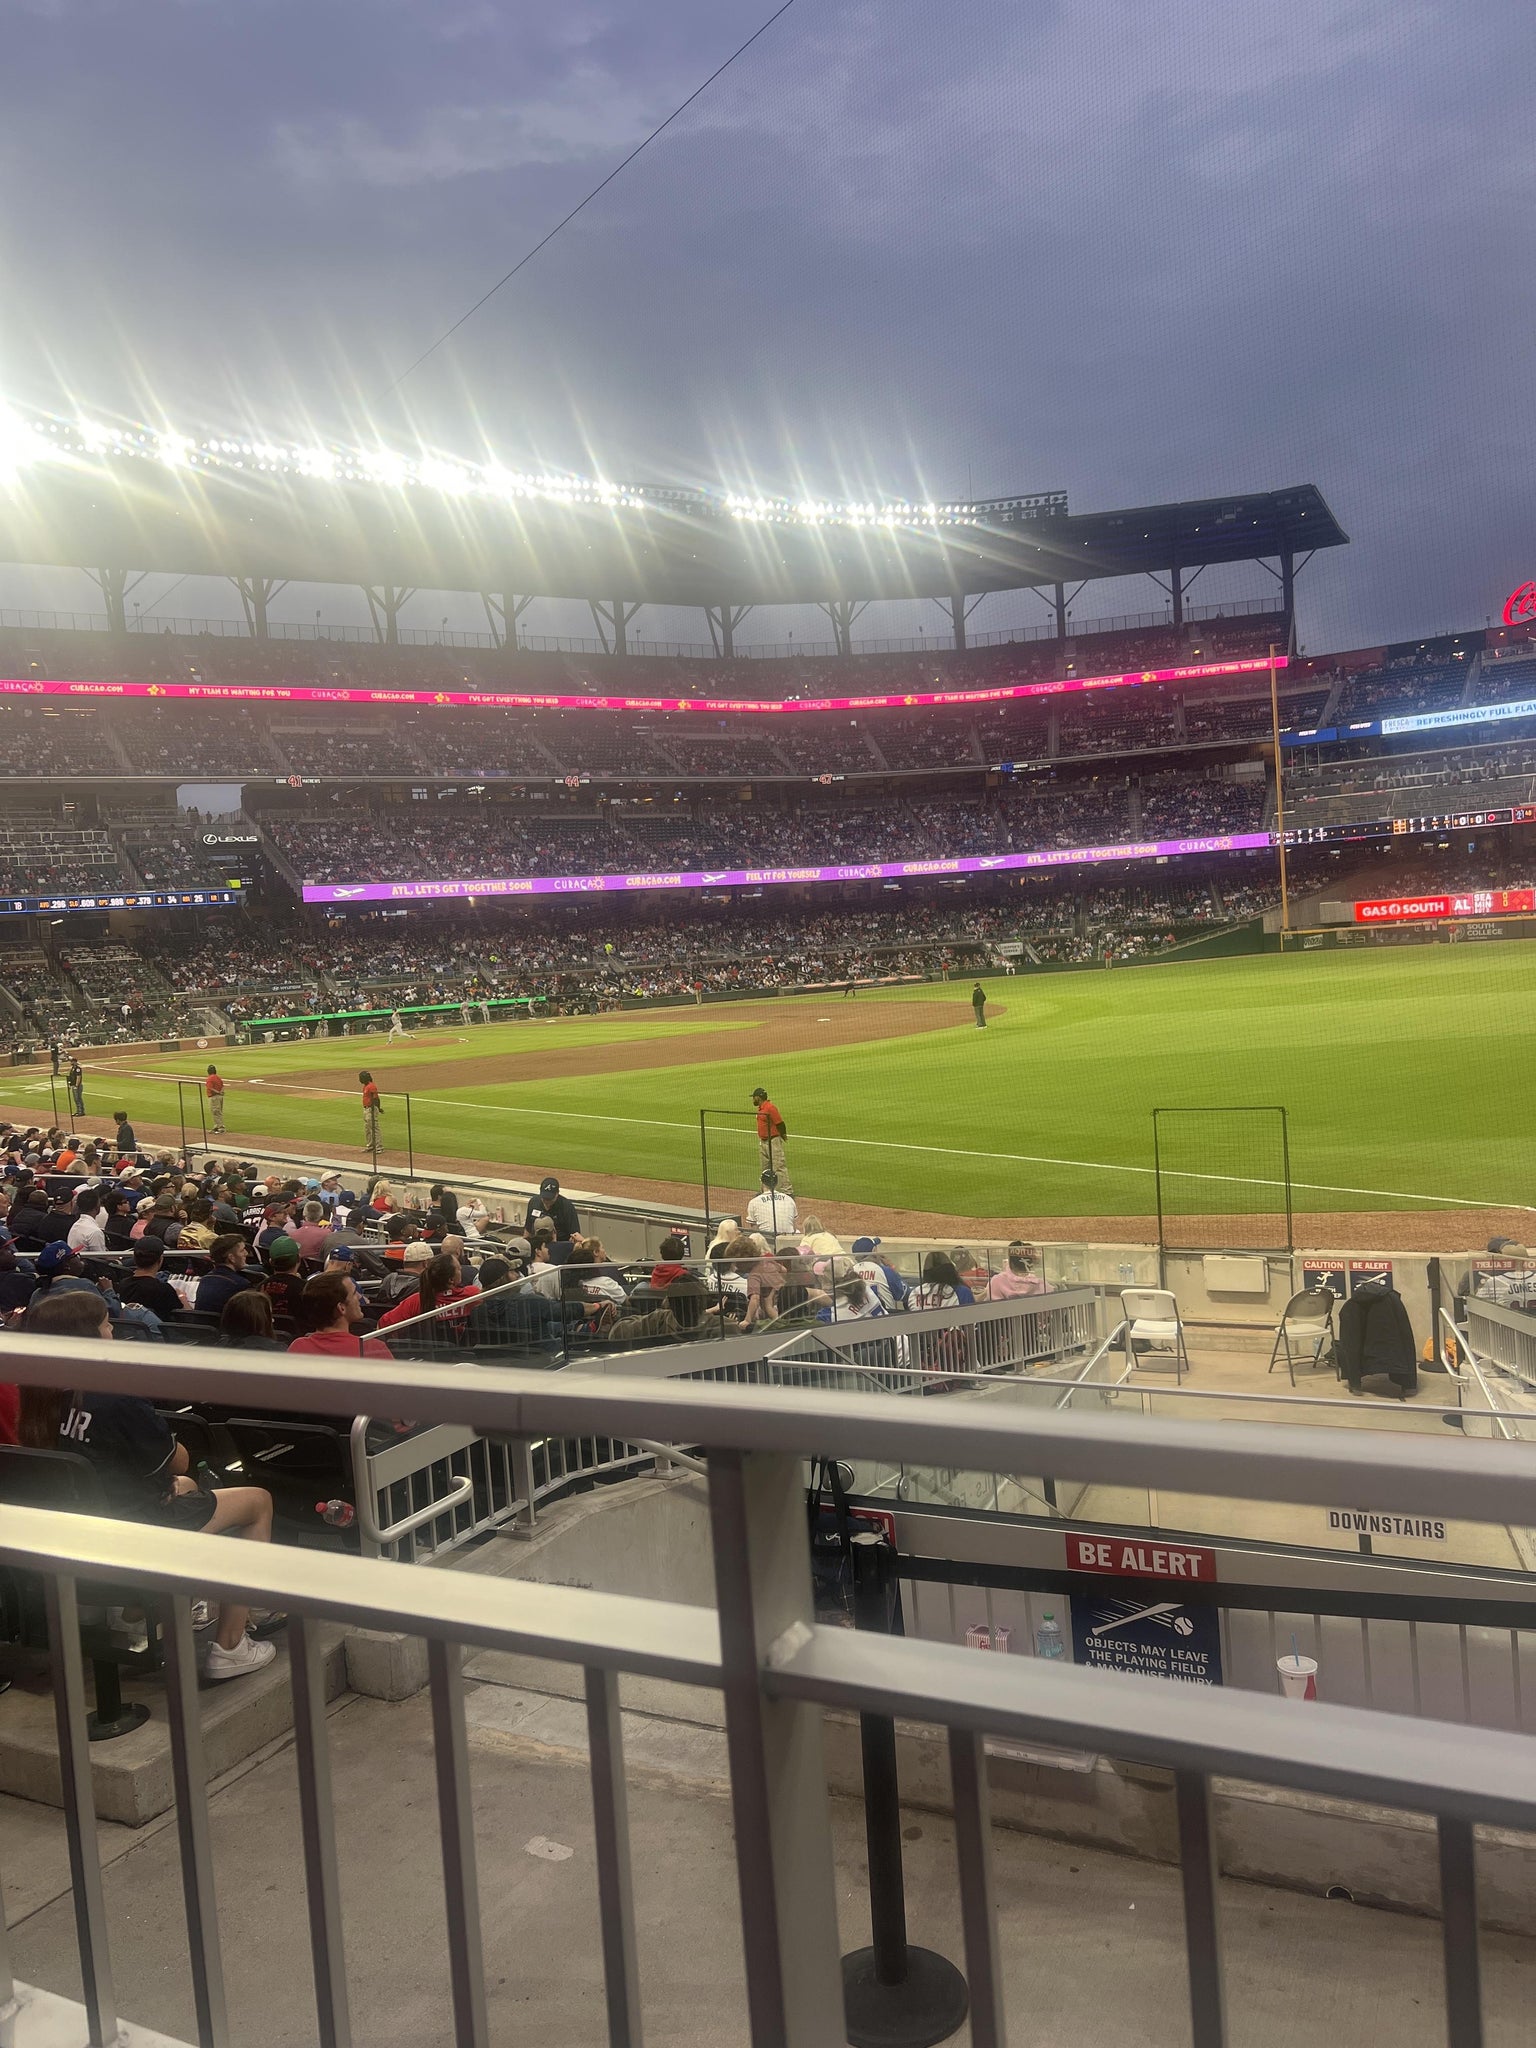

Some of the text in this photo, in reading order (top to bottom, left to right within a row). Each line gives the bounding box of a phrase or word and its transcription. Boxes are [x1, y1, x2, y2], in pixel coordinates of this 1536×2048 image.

[1416, 710, 1487, 727] REFRESHINGLY
[1489, 706, 1513, 718] FULL
[288, 774, 303, 788] 41
[565, 775, 579, 787] 44
[819, 773, 833, 785] 47
[218, 835, 258, 843] LEXUS
[1048, 852, 1070, 862] LET'S
[1071, 850, 1088, 860] GET
[1089, 847, 1132, 859] TOGETHER
[1134, 844, 1158, 855] SOON
[746, 869, 821, 881] FEEL IT FOR YOURSELF
[392, 881, 533, 896] ATL, LET'S GET TOGETHER SOON
[167, 895, 177, 904] 34
[193, 894, 204, 903] 25
[223, 893, 230, 902] 8
[1454, 899, 1471, 911] AL
[1362, 901, 1444, 917] GAS SOUTH
[1466, 922, 1495, 930] SOUTH
[1466, 928, 1504, 936] COLLEGE
[1304, 1261, 1344, 1270] CAUTION
[1365, 1262, 1388, 1270] ALERT
[60, 1407, 93, 1443] JR.
[1329, 1511, 1445, 1540] DOWNSTAIRS
[1078, 1541, 1202, 1578] BE ALERT
[1085, 1637, 1209, 1663] OBJECTS MAY LEAVE
[1088, 1650, 1206, 1675] THE PLAYING FIELD
